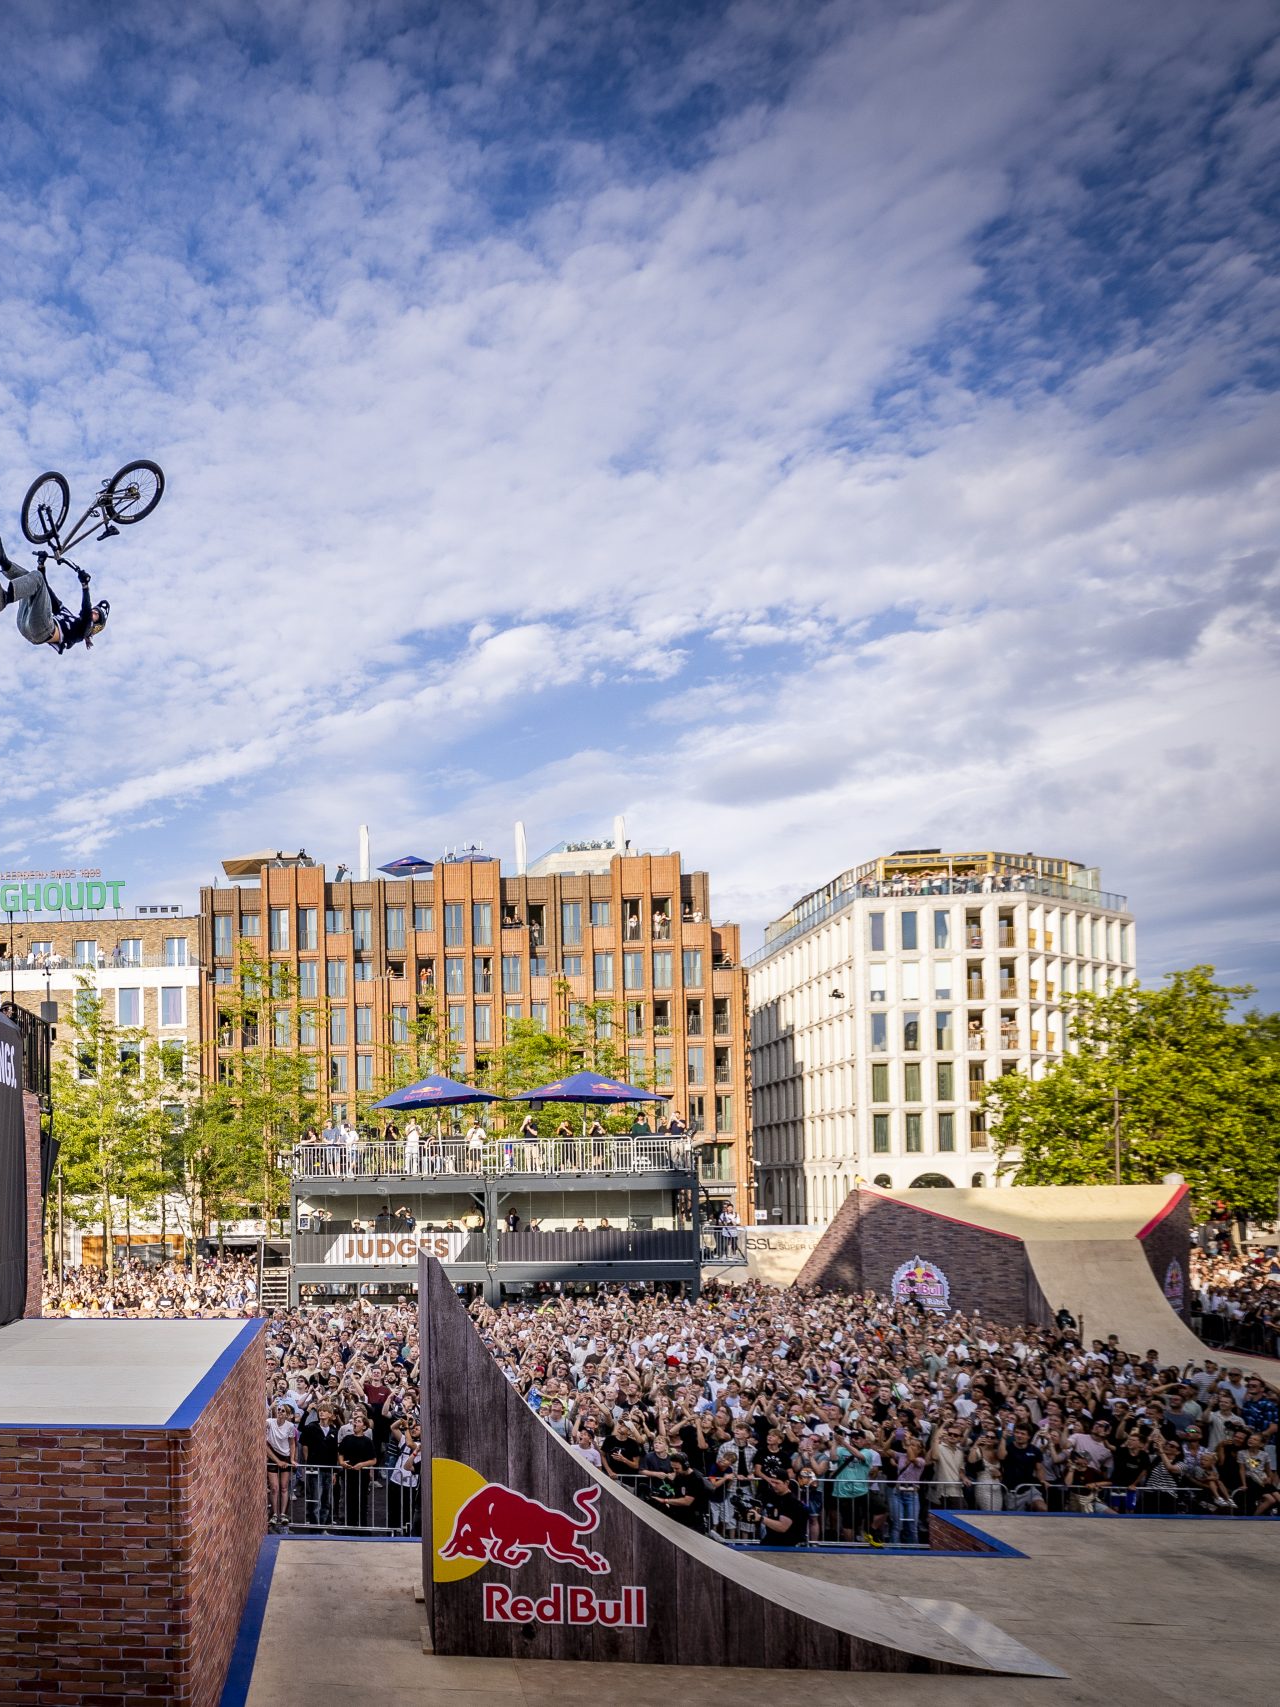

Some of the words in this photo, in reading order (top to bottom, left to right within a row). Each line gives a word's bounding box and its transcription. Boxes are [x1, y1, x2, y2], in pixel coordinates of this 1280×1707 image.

[746, 1238, 777, 1250] SSL
[920, 1284, 944, 1295] Bull
[484, 1585, 561, 1622] Red
[569, 1587, 646, 1625] Bull
